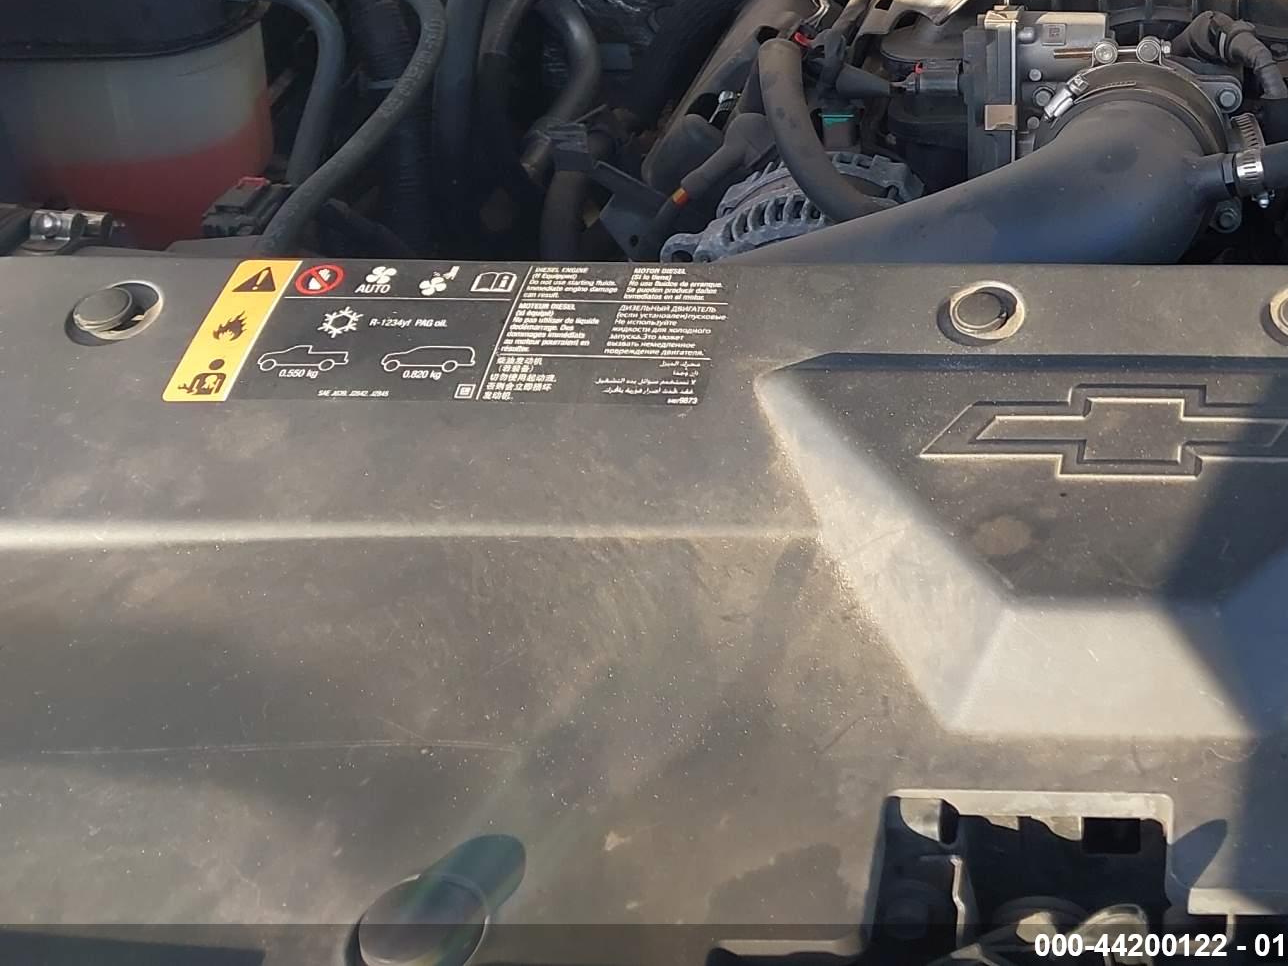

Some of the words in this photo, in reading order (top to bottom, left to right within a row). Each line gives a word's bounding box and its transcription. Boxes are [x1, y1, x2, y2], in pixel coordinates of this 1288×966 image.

[354, 284, 391, 294] AUTO
[369, 318, 412, 328] R-1234yf
[415, 319, 433, 327] PAG
[278, 369, 304, 378] 0.550
[306, 369, 319, 379] kg
[402, 370, 428, 379] 0.820
[430, 370, 442, 380] kg
